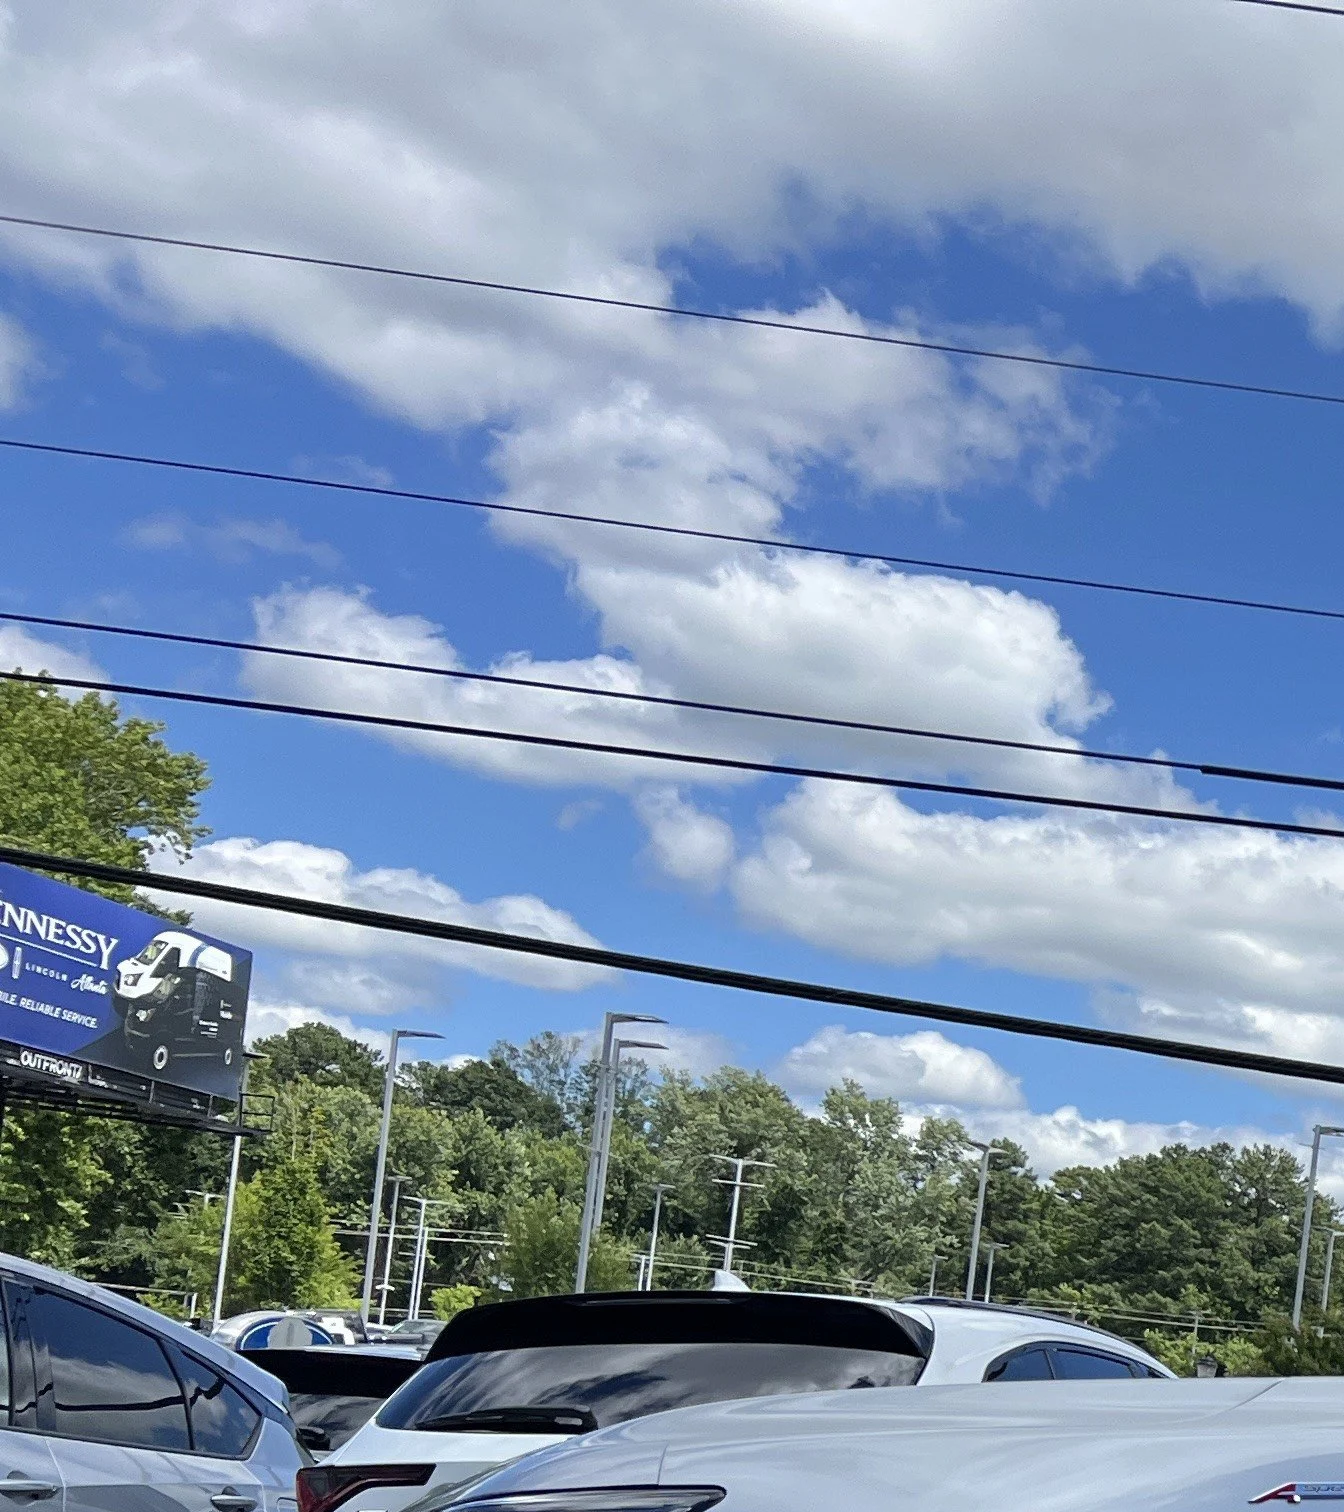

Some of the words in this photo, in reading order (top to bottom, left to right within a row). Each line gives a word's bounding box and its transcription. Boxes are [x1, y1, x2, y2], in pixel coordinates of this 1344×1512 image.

[0, 900, 118, 970] NNESSY
[25, 962, 68, 982] LINCOLN
[19, 997, 61, 1019] RELIABLE
